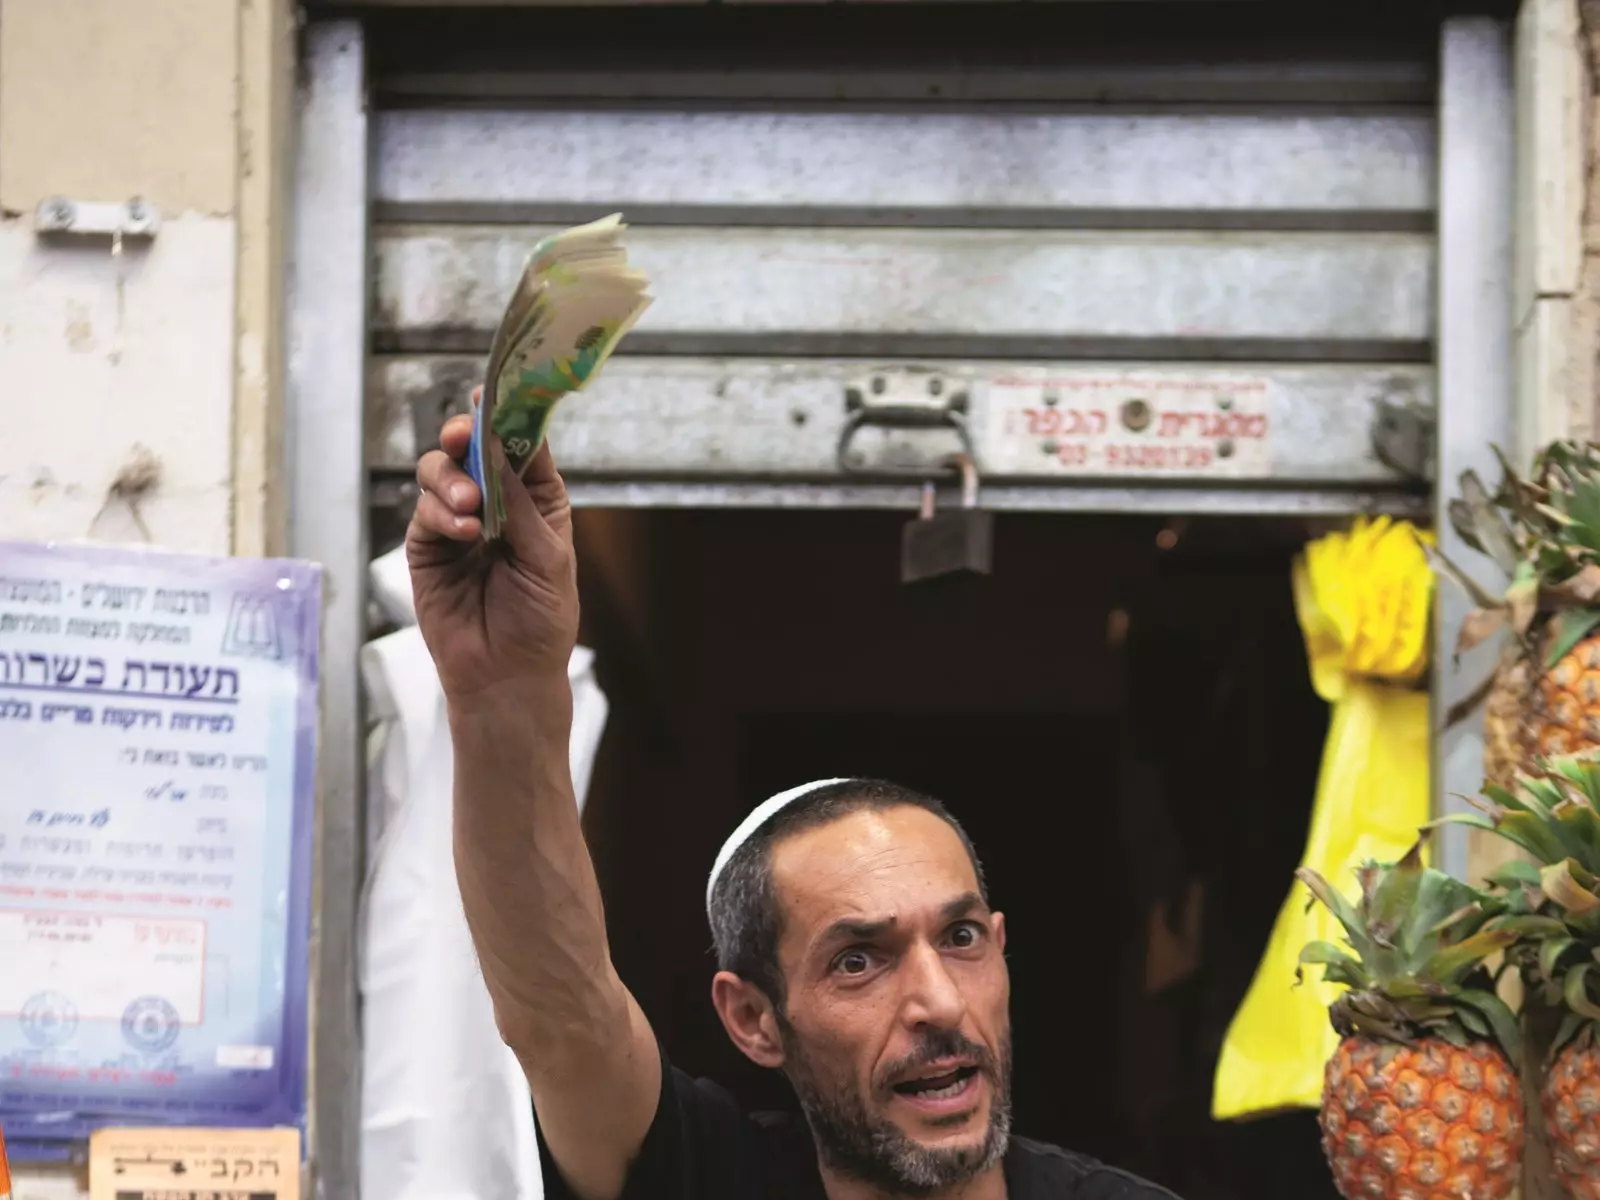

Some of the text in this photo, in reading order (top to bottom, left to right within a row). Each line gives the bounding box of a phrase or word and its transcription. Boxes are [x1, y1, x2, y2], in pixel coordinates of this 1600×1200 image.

[503, 437, 531, 455] 50
[122, 660, 240, 698] תעודת
[102, 705, 163, 732] וירקות
[169, 710, 235, 734] לפירות
